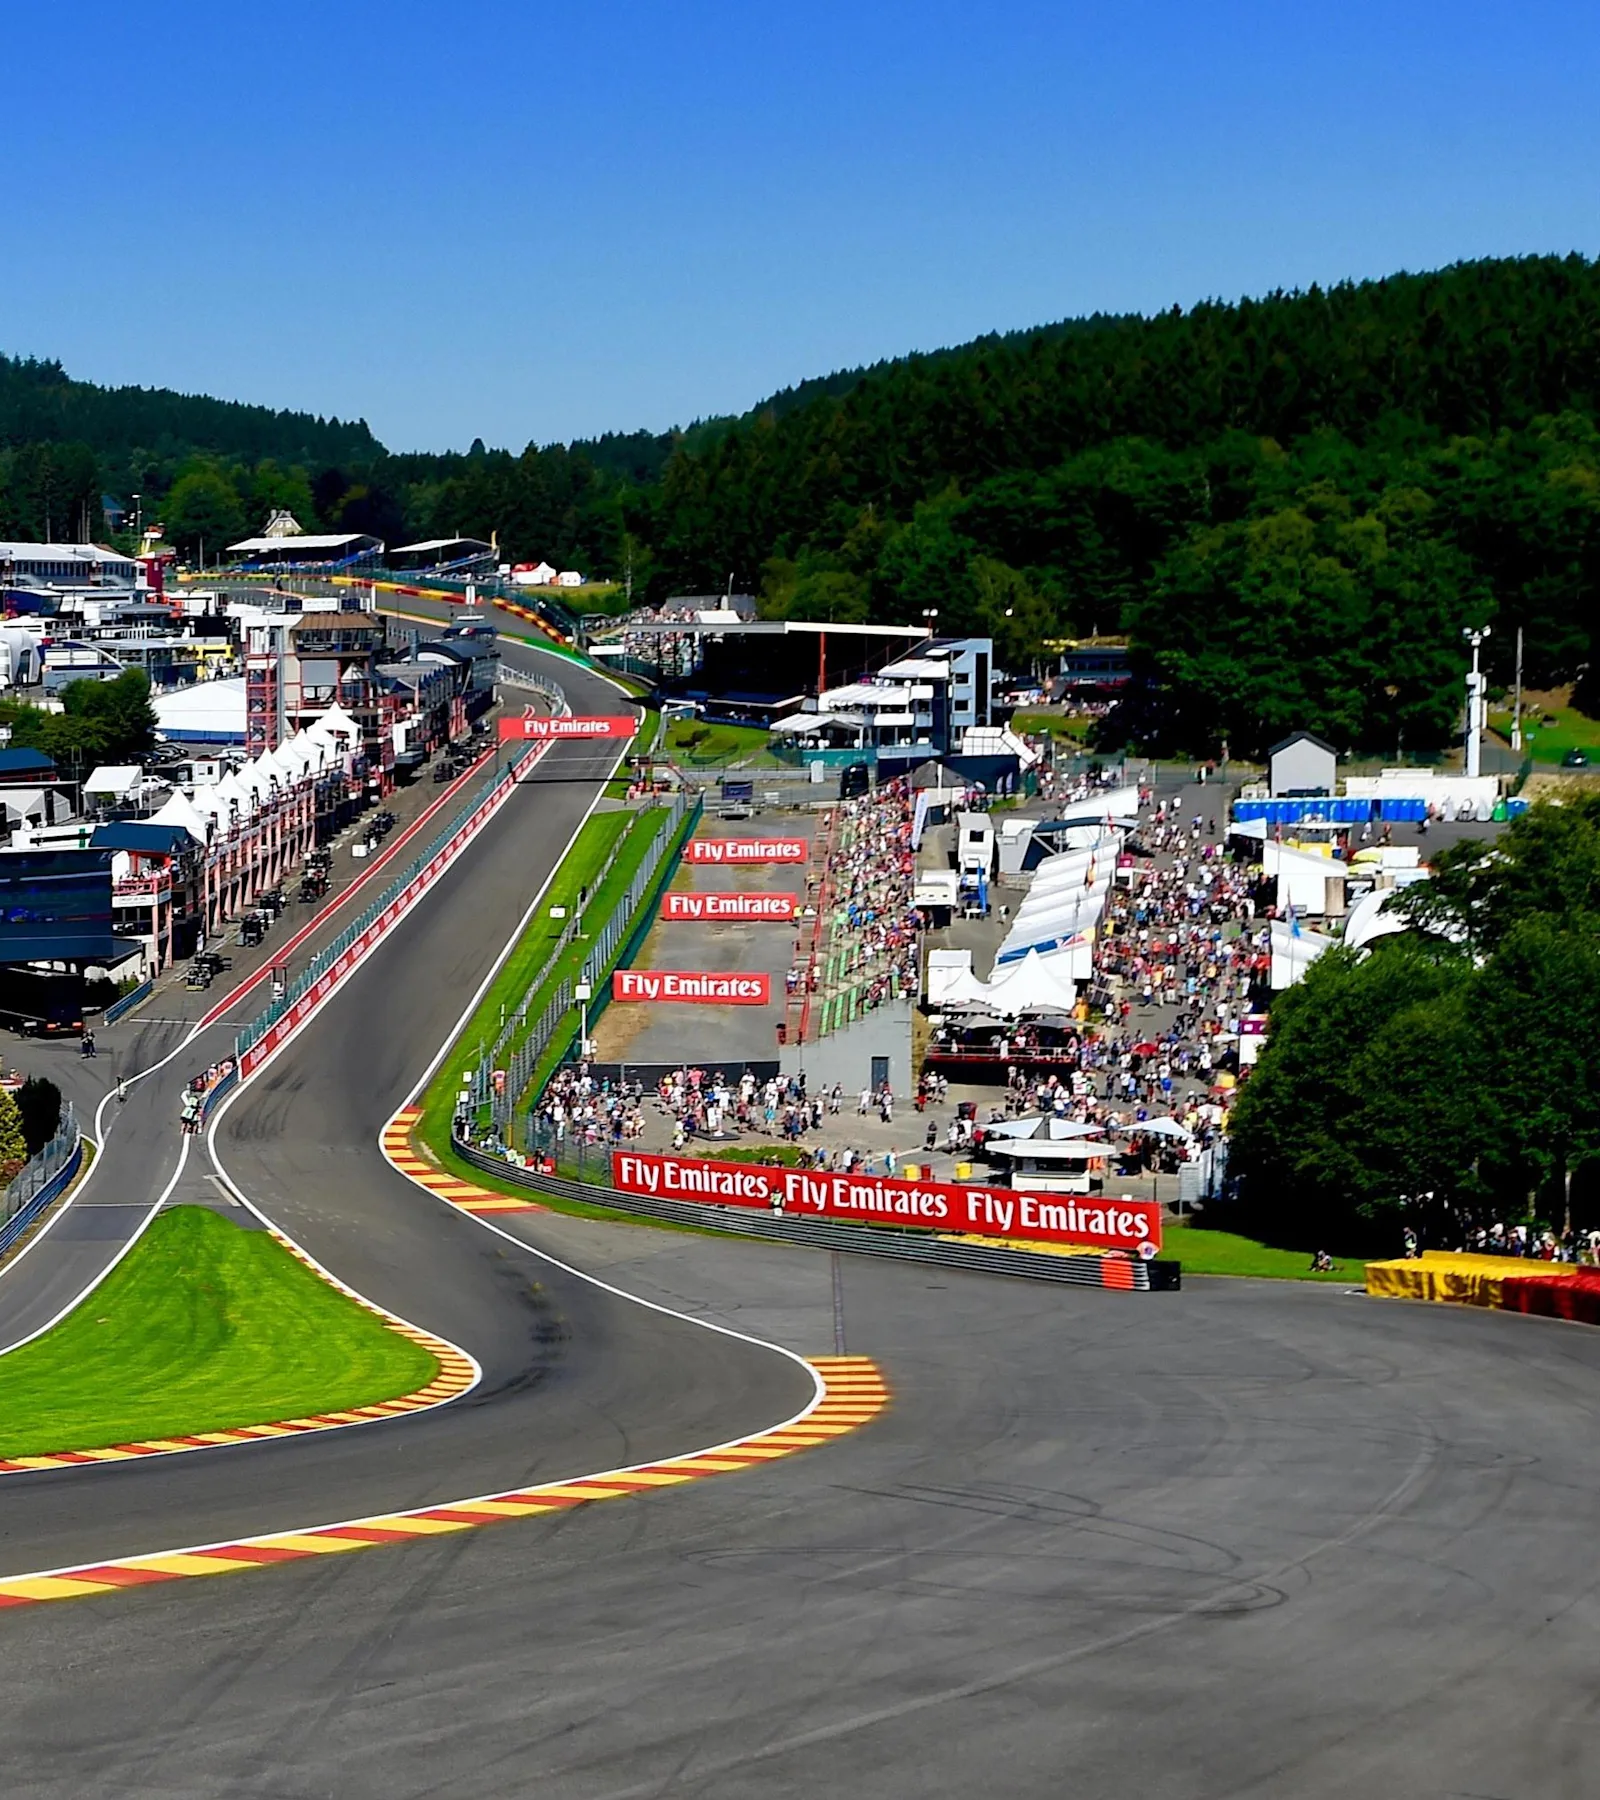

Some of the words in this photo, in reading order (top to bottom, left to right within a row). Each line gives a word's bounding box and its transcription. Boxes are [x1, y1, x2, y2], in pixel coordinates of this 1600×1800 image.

[524, 720, 549, 735] Fly
[550, 719, 610, 733] Emirates
[694, 842, 723, 861] Fly
[725, 840, 801, 858] Emirates
[670, 896, 703, 917] Fly
[705, 895, 790, 914] Emirates
[622, 974, 660, 999] Fly
[664, 975, 762, 997] Emirates
[620, 1157, 659, 1192] Fly
[663, 1161, 769, 1198] Emirates
[785, 1173, 828, 1211] Fly
[832, 1178, 948, 1217] Emirates
[966, 1191, 1013, 1231] Fly
[1019, 1196, 1149, 1239] Emirates
